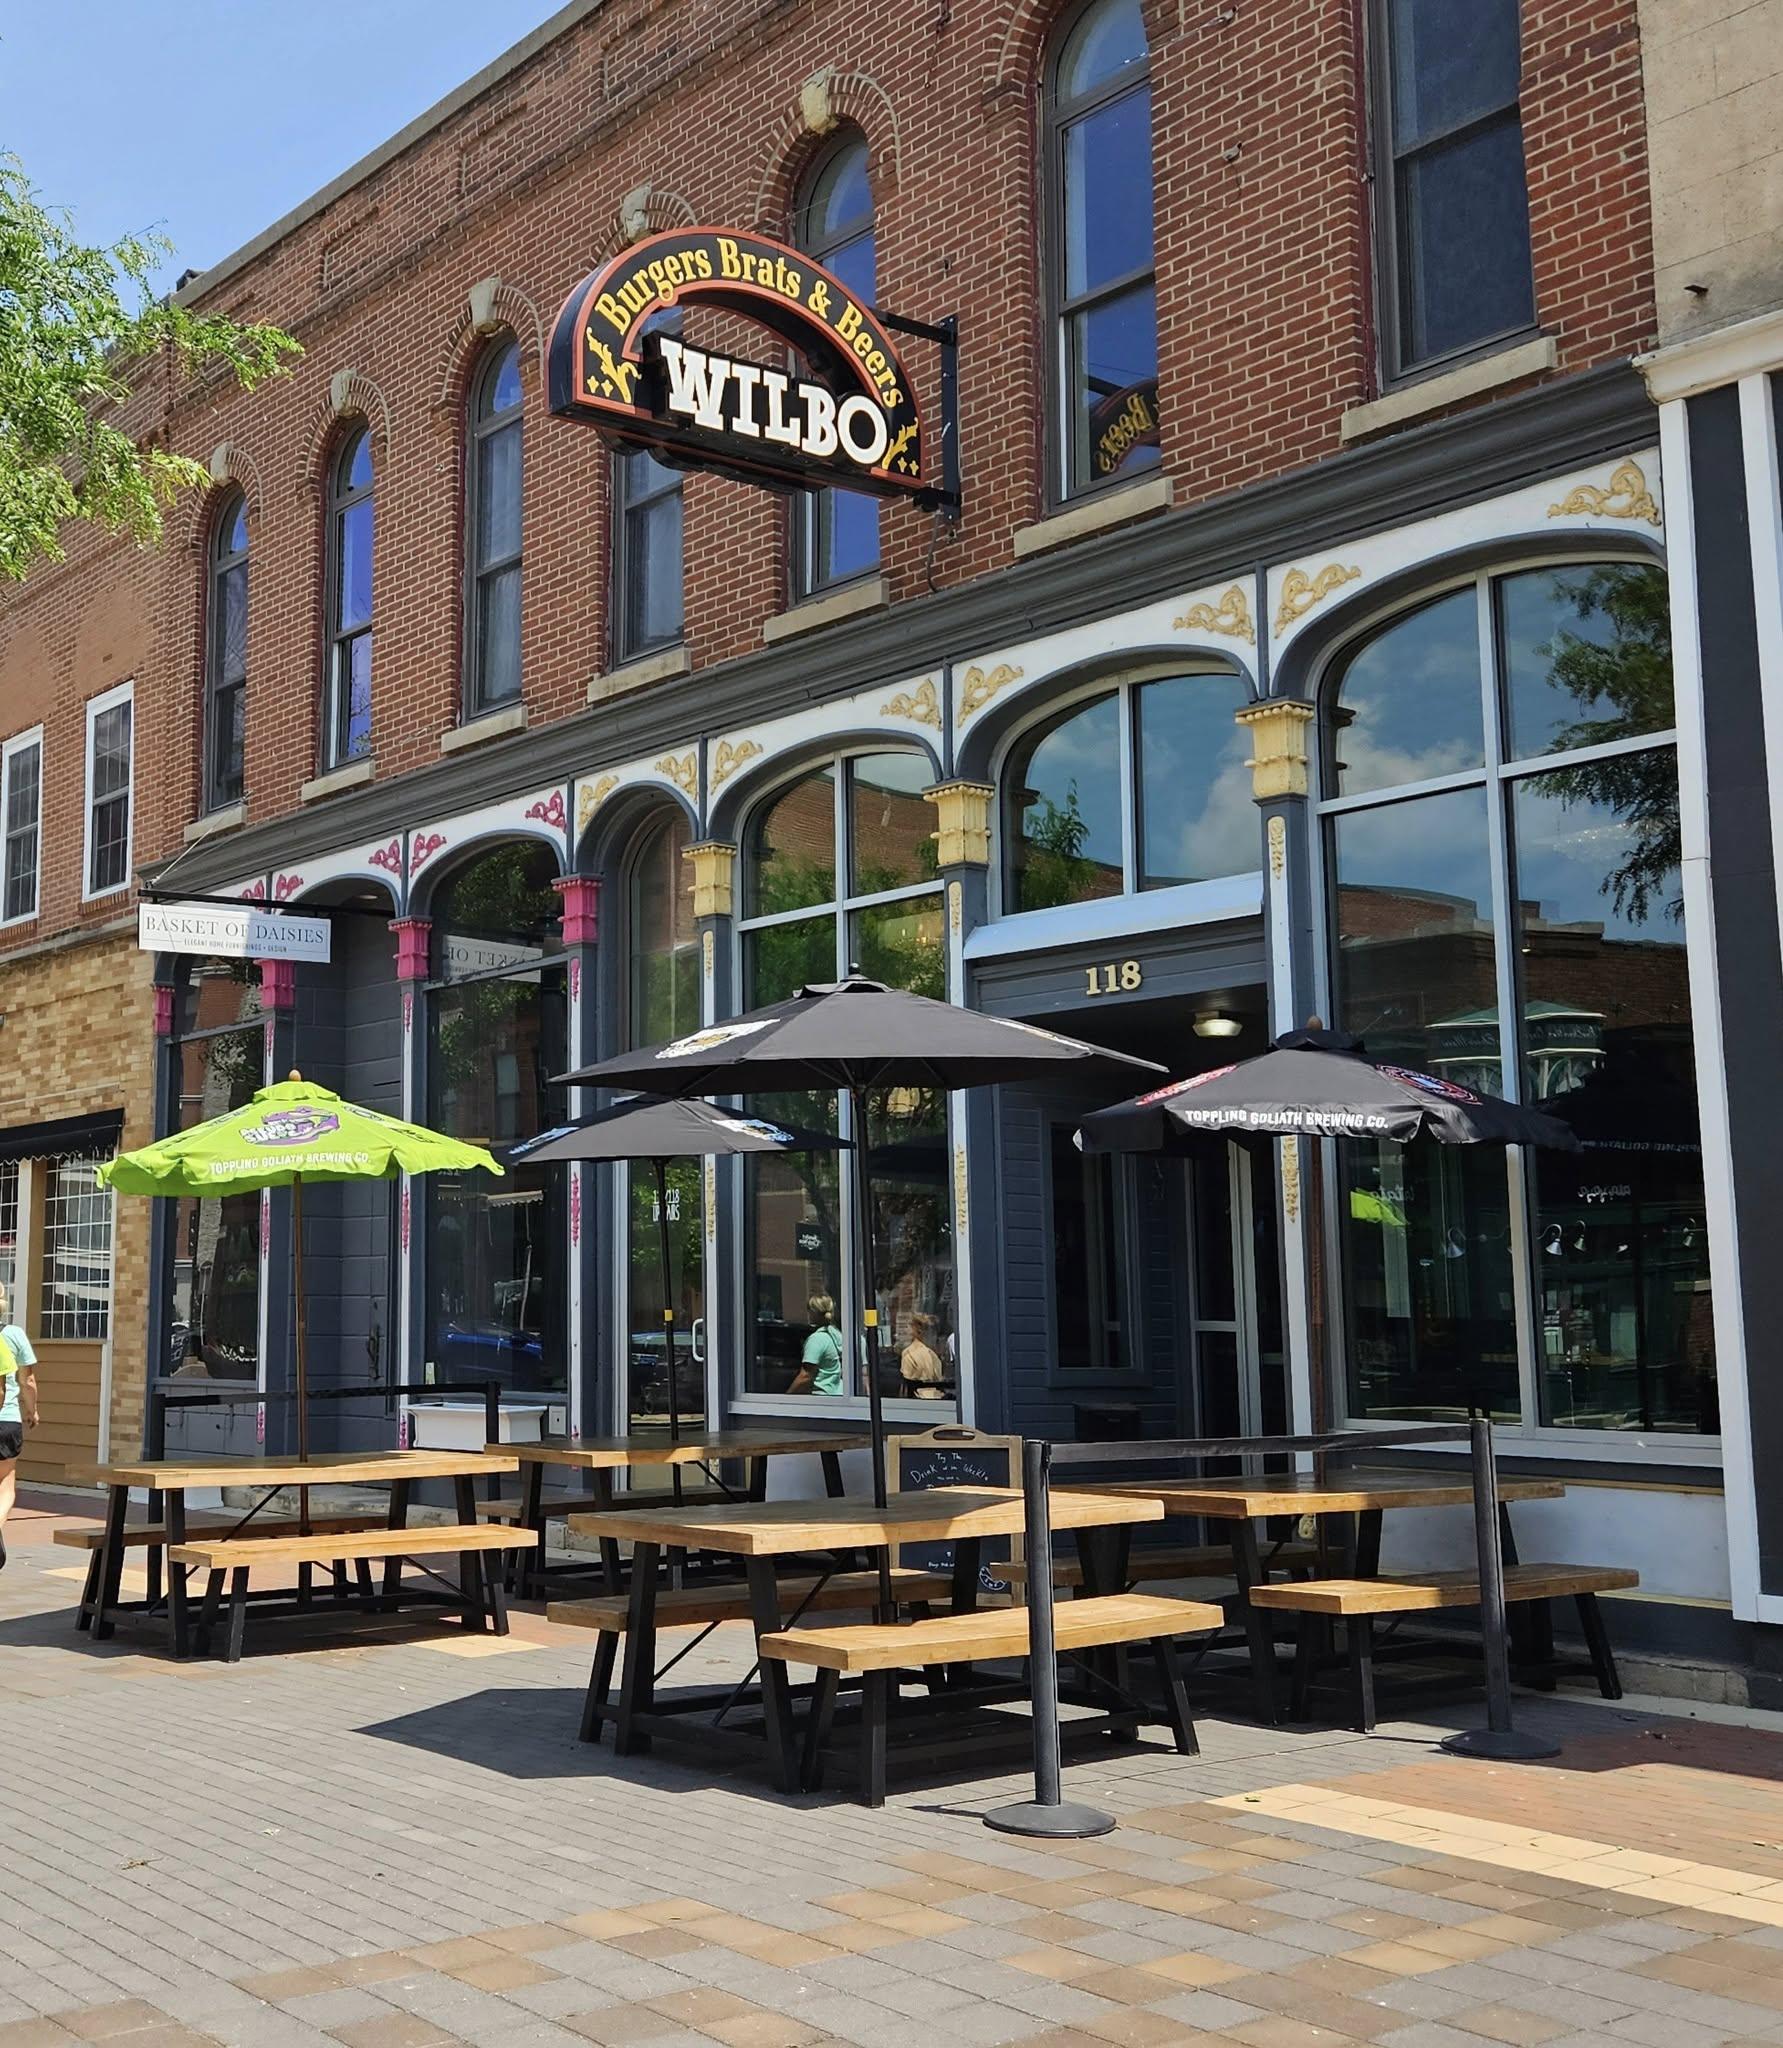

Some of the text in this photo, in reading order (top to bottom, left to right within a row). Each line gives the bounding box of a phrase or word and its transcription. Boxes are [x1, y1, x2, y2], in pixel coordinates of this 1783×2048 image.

[595, 237, 905, 408] Burgers Brats & Beers
[660, 336, 888, 464] WILBO
[146, 915, 324, 944] BASKET OF DAISIES
[1085, 960, 1142, 996] 118
[1185, 1109, 1389, 1129] TOPPLING GOLIATH BREWING CO.
[209, 1151, 372, 1176] TOPPLING GOLIATH BREWING CO.
